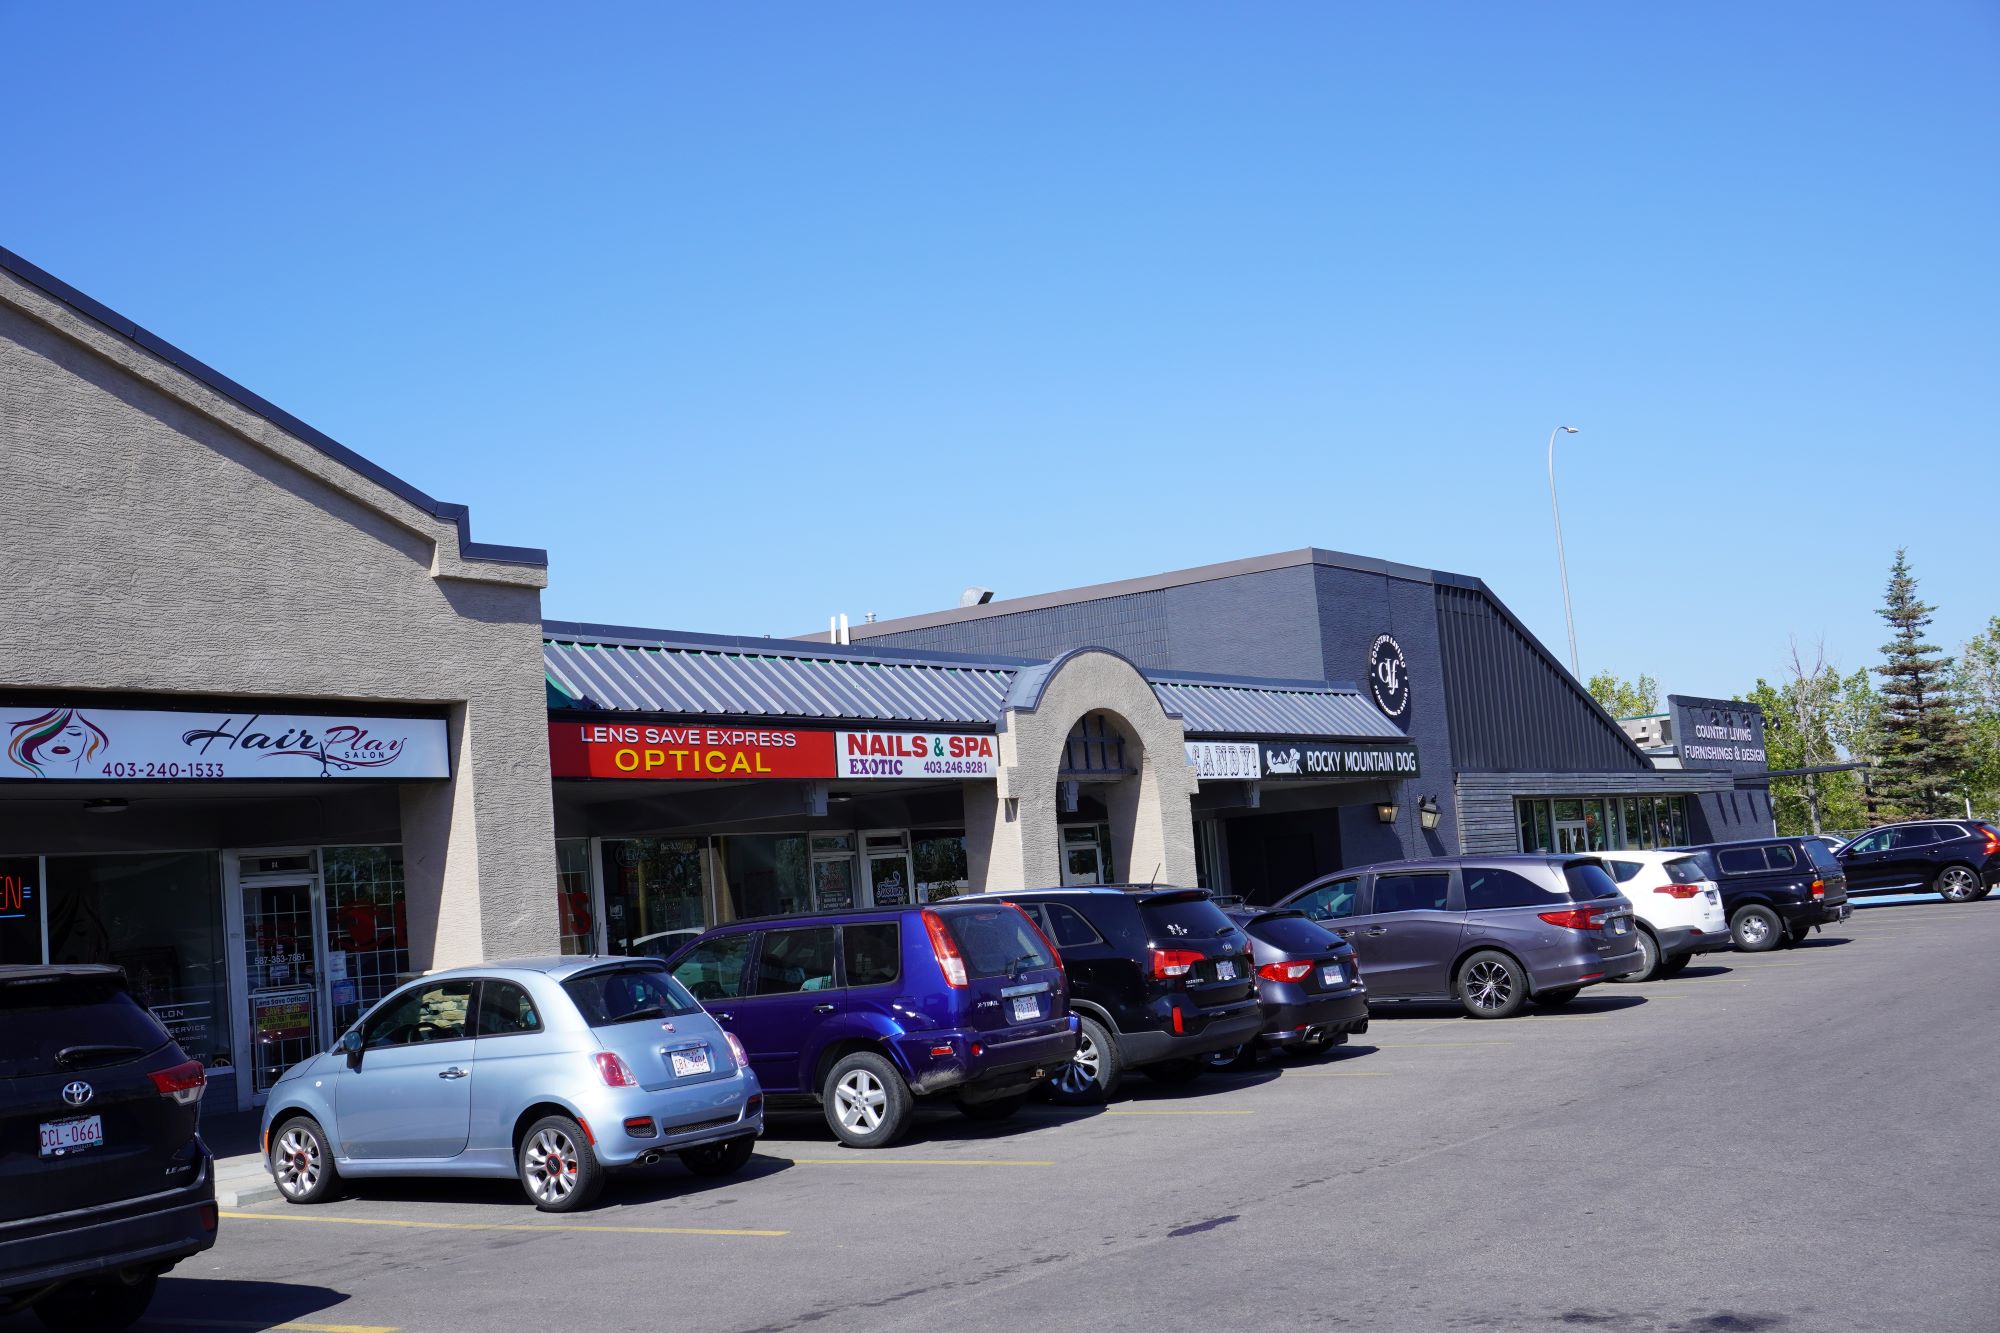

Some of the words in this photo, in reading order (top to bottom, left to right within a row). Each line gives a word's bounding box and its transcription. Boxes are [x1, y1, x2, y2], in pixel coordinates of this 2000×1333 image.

[182, 713, 319, 755] Hair
[580, 727, 639, 743] LENS
[645, 728, 701, 744] SAVE
[706, 731, 797, 747] EXPRESS
[1695, 725, 1728, 740] COUNTRY
[1729, 727, 1752, 742] LIVING
[847, 733, 929, 758] NAILS
[933, 737, 945, 757] &
[948, 736, 993, 758] SPA
[1684, 745, 1733, 760] FURNISHINGS
[1734, 746, 1741, 760] &
[1741, 748, 1766, 762] DESIGN
[344, 751, 385, 759] SALON
[614, 748, 772, 773] OPTICAL
[1306, 751, 1341, 772] ROCKY
[1344, 751, 1394, 772] MOUNTAIN
[1396, 752, 1416, 772] DOG
[102, 762, 224, 777] 403-240-1533
[849, 758, 903, 775] EXOTIC
[923, 761, 988, 773] 403.246.9281
[170, 1025, 206, 1034] SERVICE
[41, 1122, 103, 1148] CCL-0661
